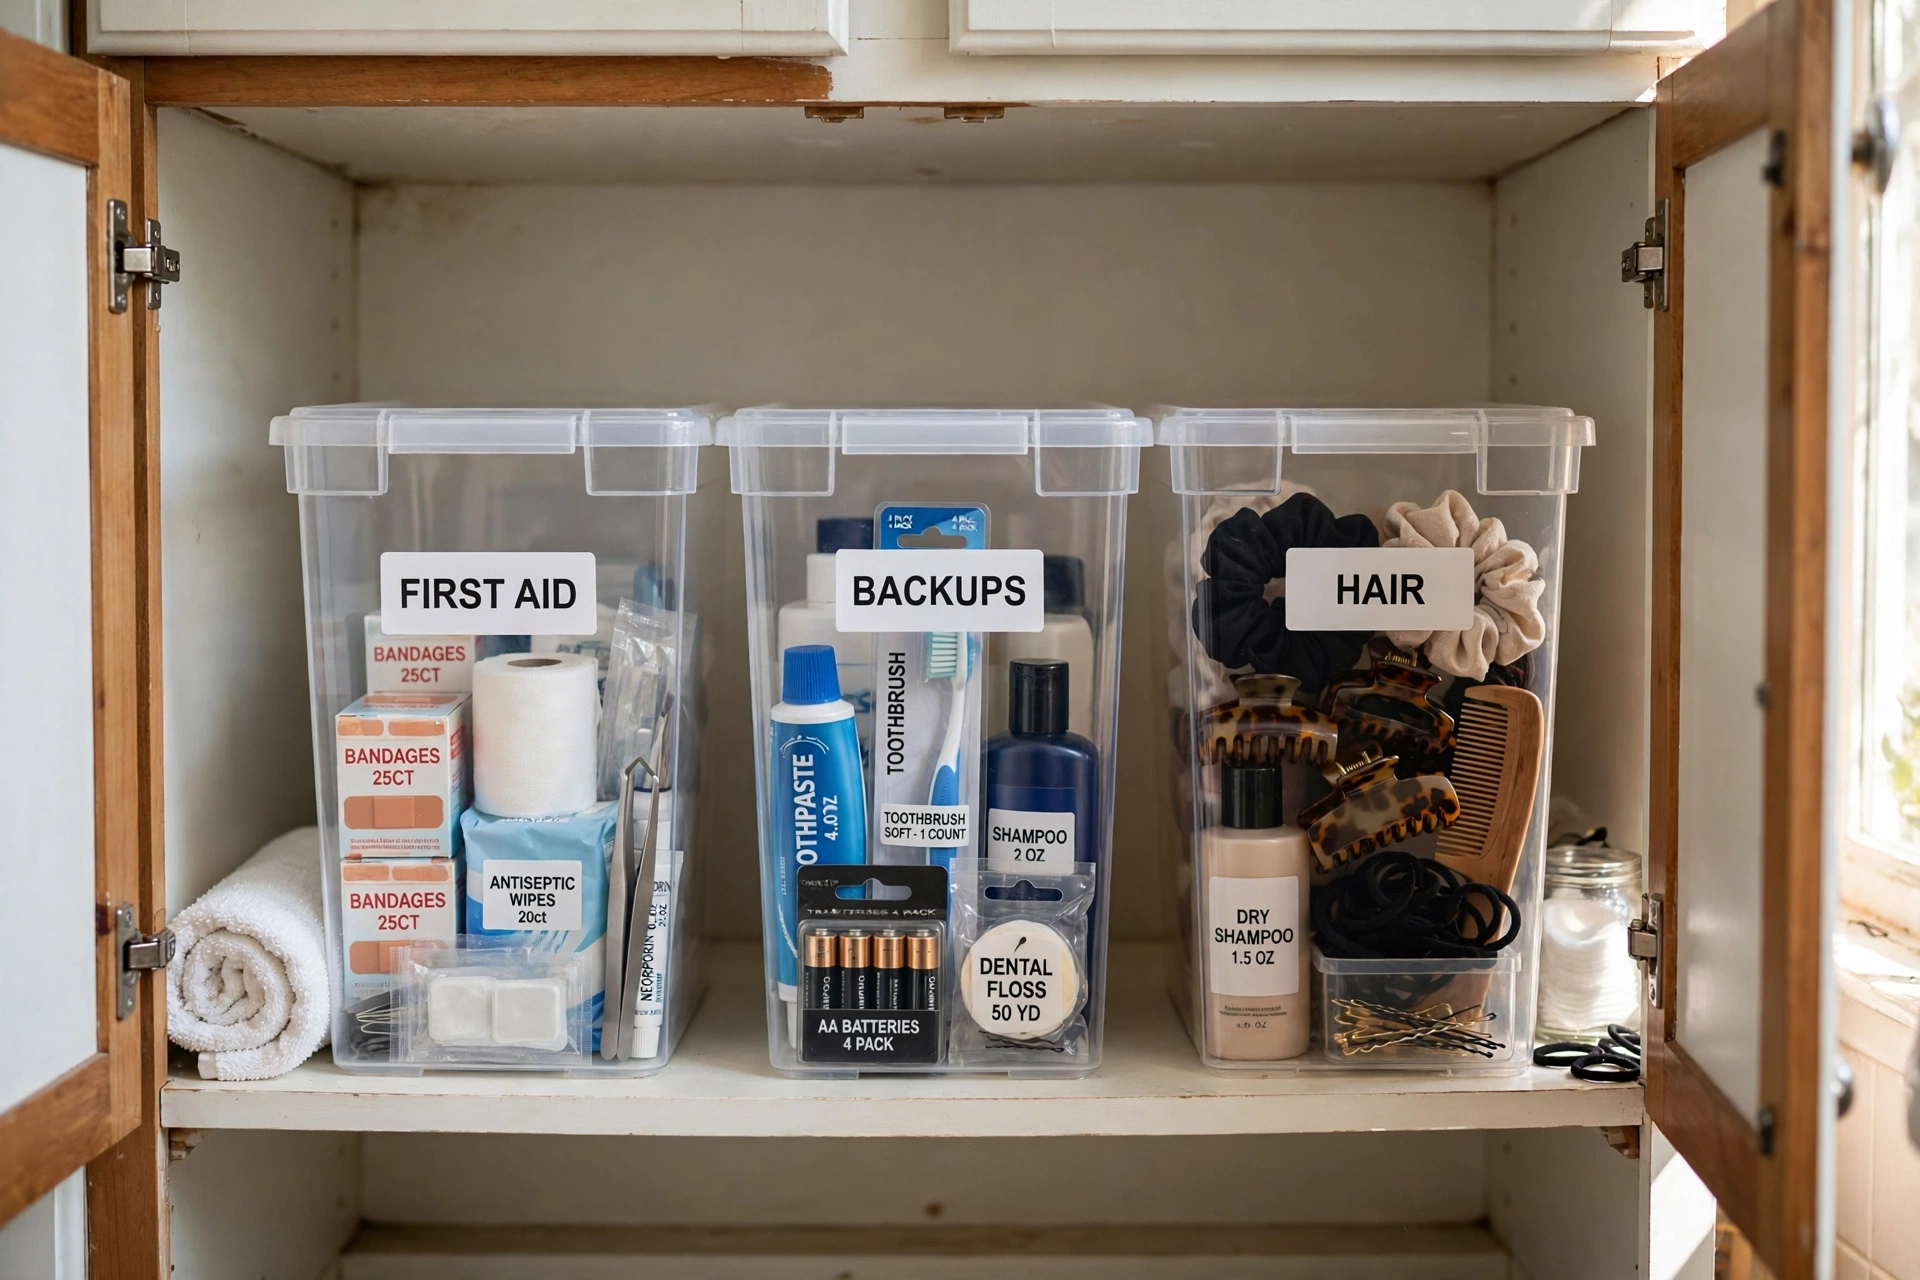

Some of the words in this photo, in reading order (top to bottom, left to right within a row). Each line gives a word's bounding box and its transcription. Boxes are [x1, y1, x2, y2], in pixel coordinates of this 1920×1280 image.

[400, 577, 505, 610] FIRST
[514, 577, 577, 610] AID
[853, 575, 1026, 607] BACKUPS
[1337, 573, 1426, 605] HAIR
[374, 645, 466, 662] BANDAGES
[401, 667, 441, 683] 25CT
[886, 652, 906, 776] TOOTHBRUSH
[345, 747, 441, 765] BANDAGES
[372, 769, 415, 786] 25CT
[792, 754, 818, 866] OTHPASTE
[883, 811, 966, 826] TOOTHBRUSH
[884, 826, 912, 840] SOFT
[920, 828, 925, 840] 1
[928, 828, 967, 841] COUNT
[992, 826, 1068, 845] SHAMPOO
[1013, 847, 1022, 861] 2
[1025, 847, 1046, 862] OZ
[489, 875, 576, 891] ANTISEPTIC
[350, 891, 446, 909] BANDAGES
[509, 892, 556, 908] WIPES
[377, 914, 420, 931] 25CT
[518, 910, 547, 924] 20ct
[1237, 908, 1270, 925] DRY
[1214, 927, 1294, 945] SHAMPOO
[980, 957, 1053, 976] DENTAL
[1232, 950, 1252, 966] 1.5
[1255, 950, 1275, 966] OZ
[987, 980, 1047, 999] FLOSS
[991, 1004, 1012, 1022] 50
[1018, 1004, 1041, 1022] YD
[817, 1018, 839, 1034] AA
[842, 1018, 920, 1034] BATTERIES
[842, 1036, 852, 1051] 4
[856, 1036, 894, 1052] PACK
